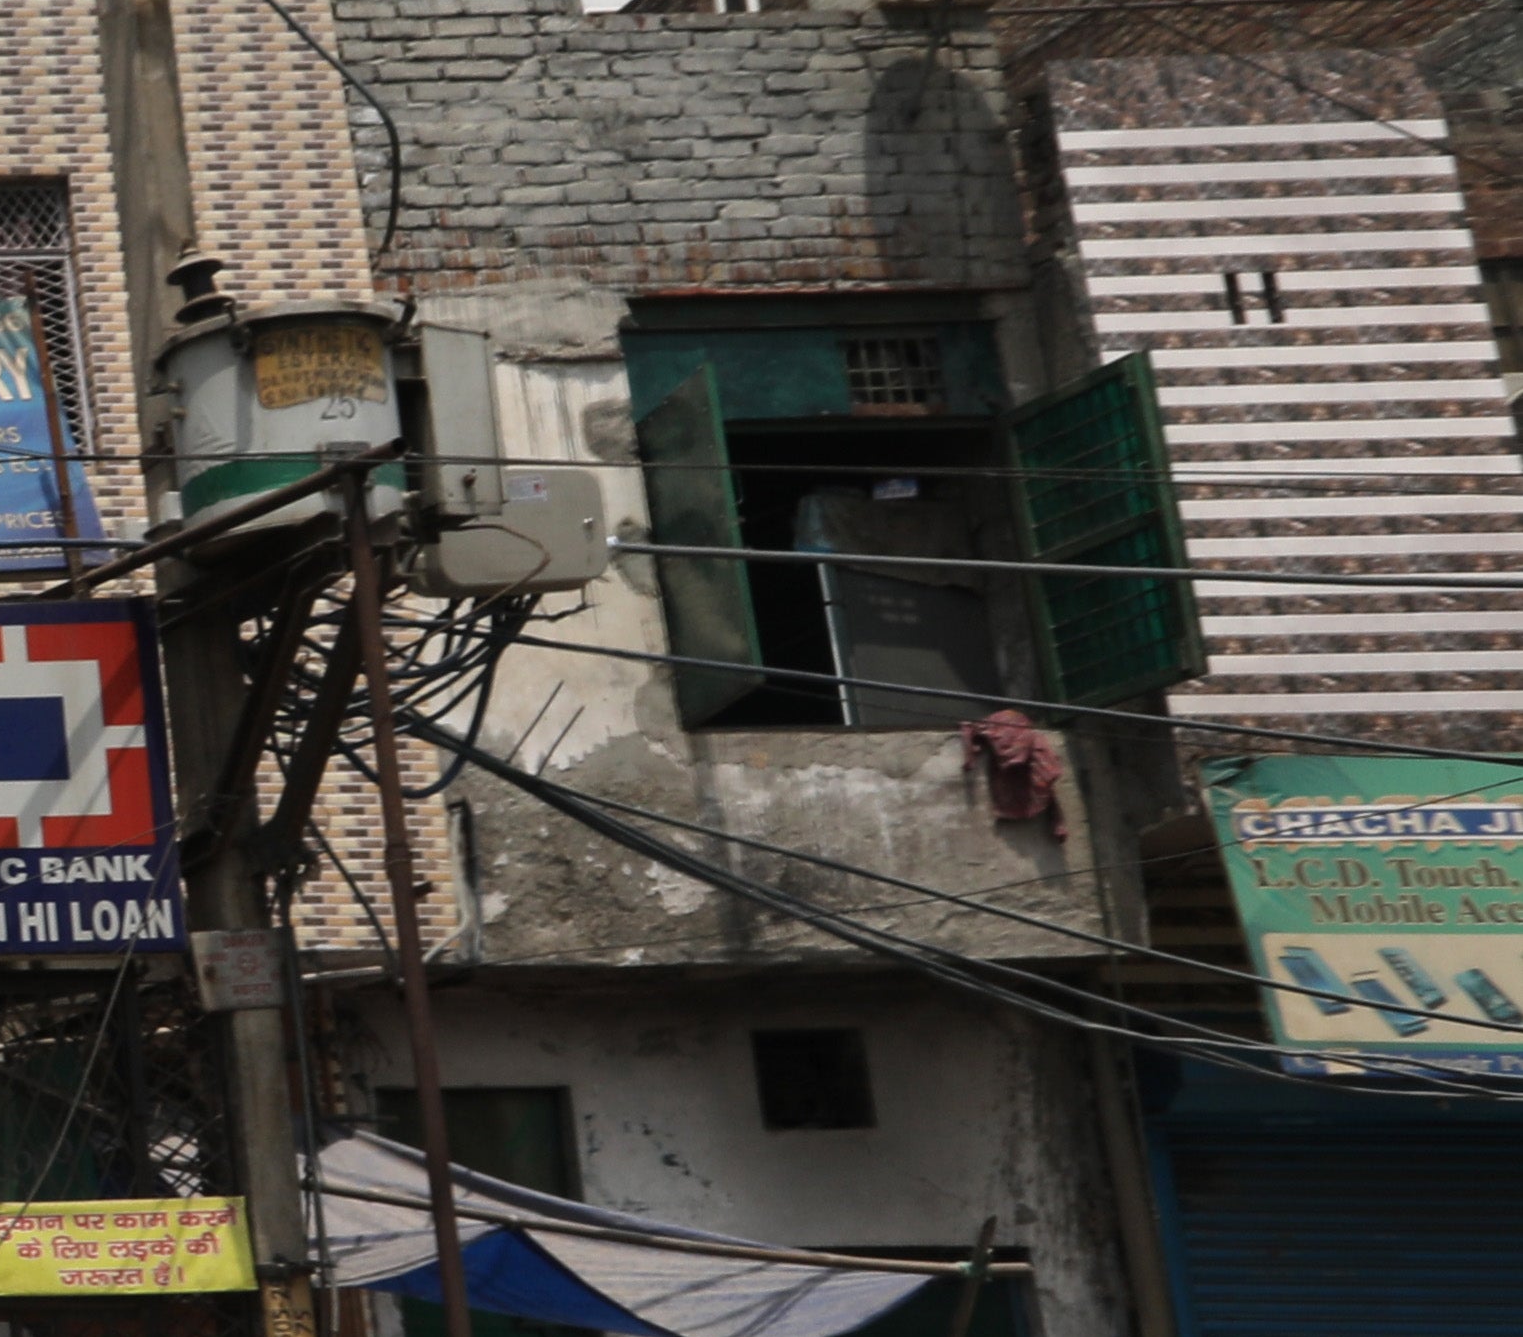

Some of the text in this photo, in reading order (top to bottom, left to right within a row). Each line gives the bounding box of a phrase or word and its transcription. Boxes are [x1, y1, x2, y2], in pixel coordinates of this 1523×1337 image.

[1239, 812, 1466, 836] CHACHA
[39, 854, 156, 884] BANK
[1248, 857, 1522, 894] L.C.D. Touch,
[18, 901, 59, 943] HI
[69, 899, 176, 941] LOAN
[1307, 893, 1448, 925] Mobile
[72, 1212, 105, 1230] पर
[113, 1210, 169, 1230] काम
[177, 1205, 238, 1228] करने
[16, 1237, 43, 1260] के
[51, 1235, 99, 1260] लिए
[184, 1231, 221, 1255] की
